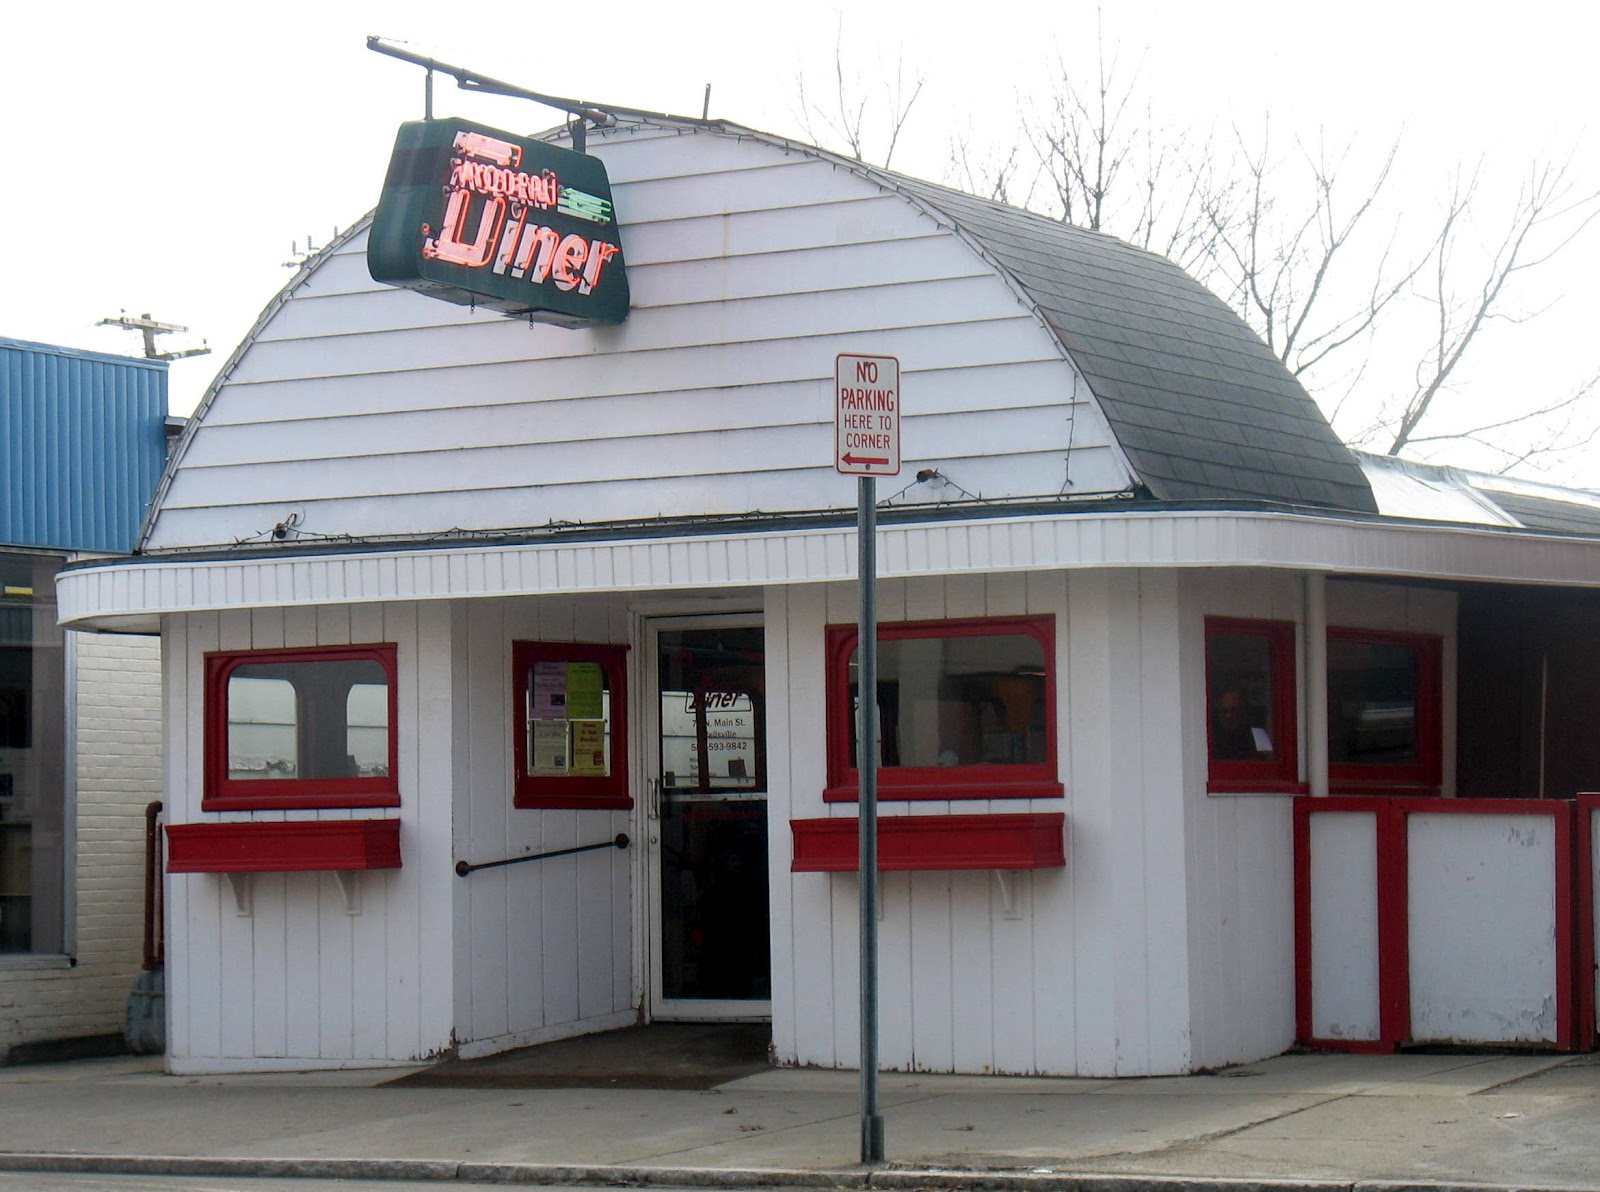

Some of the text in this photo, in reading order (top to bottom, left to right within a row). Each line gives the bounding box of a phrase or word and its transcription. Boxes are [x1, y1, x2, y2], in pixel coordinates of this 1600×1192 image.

[451, 160, 559, 211] MODERN
[422, 131, 619, 296] Diner
[856, 361, 878, 384] NO
[841, 388, 895, 412] PARKING
[844, 414, 892, 431] HERE TO
[845, 433, 891, 449] CORNER
[714, 718, 733, 727] Main
[735, 718, 746, 727] St.
[704, 730, 737, 739] ellsville
[691, 741, 747, 752] 5-593-9842
